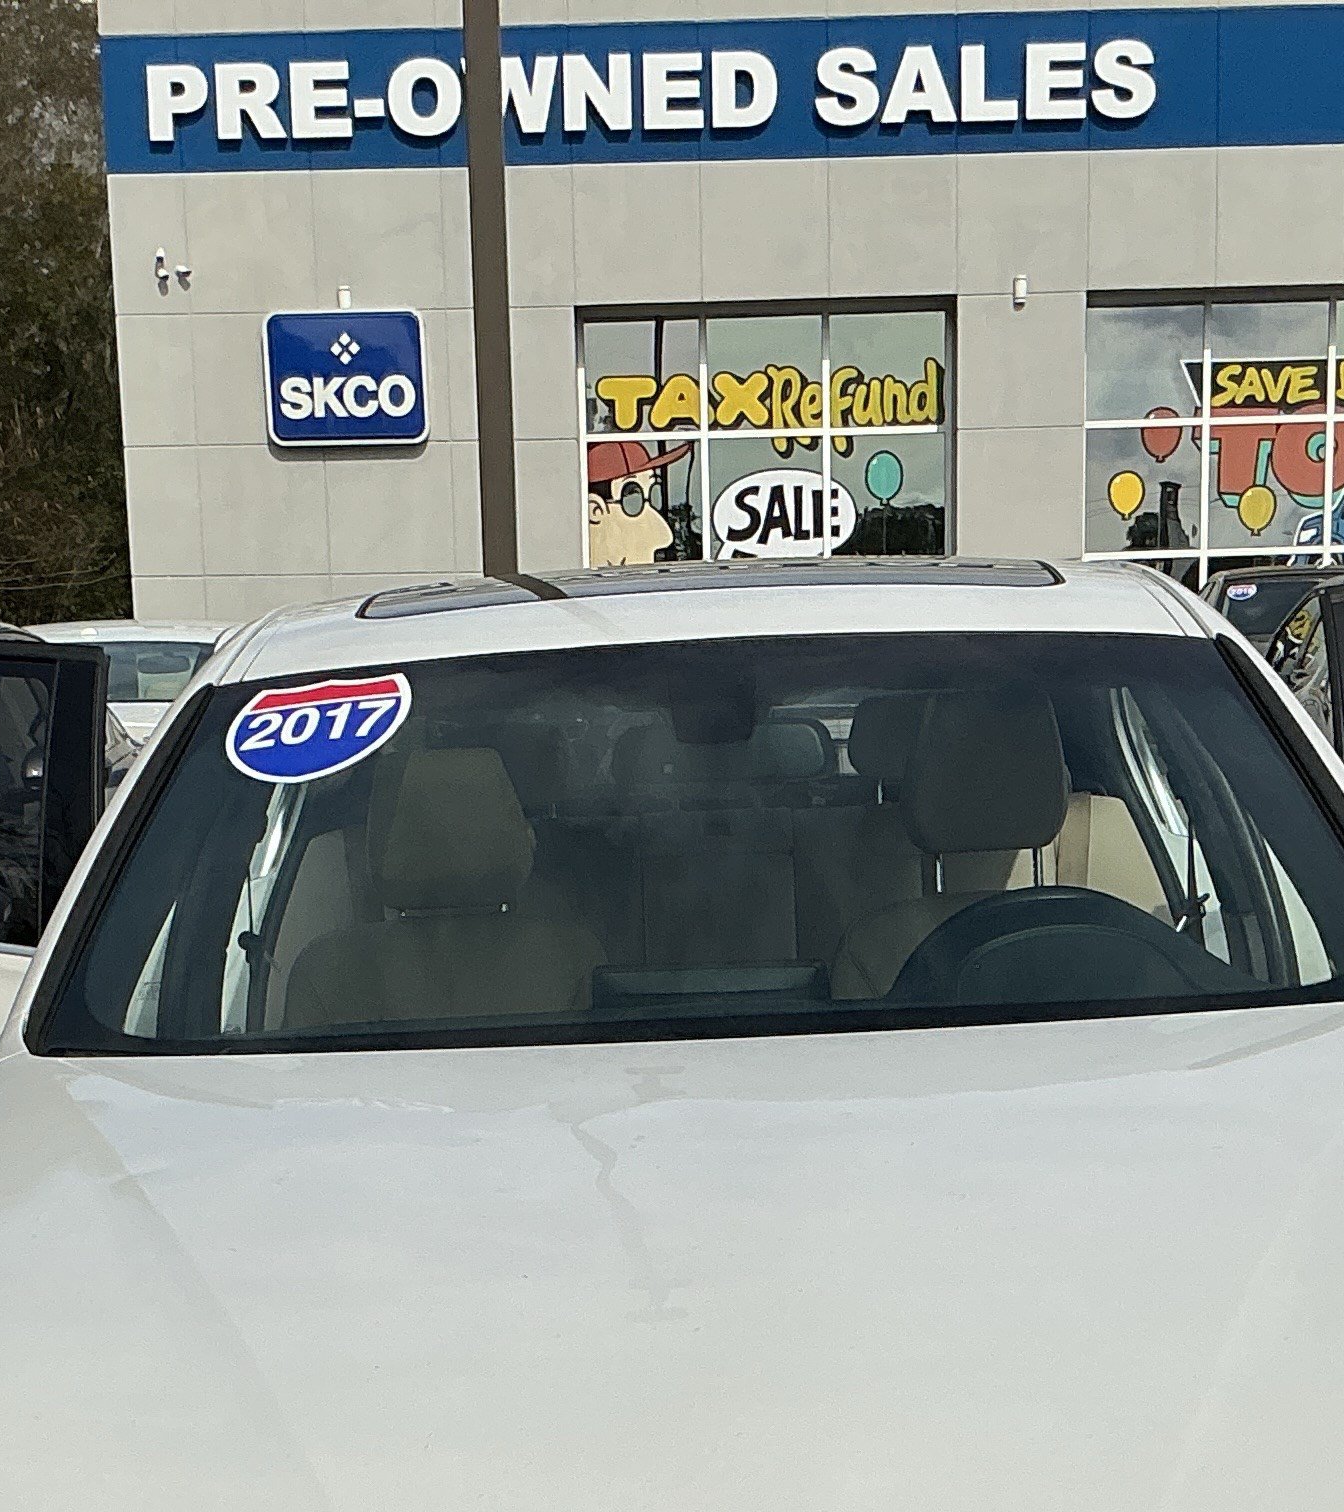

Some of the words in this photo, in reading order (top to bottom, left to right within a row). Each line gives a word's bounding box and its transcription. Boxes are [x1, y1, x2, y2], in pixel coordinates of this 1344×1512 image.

[145, 51, 779, 142] PRE-OWNED
[814, 39, 1157, 127] SALES
[279, 374, 417, 420] SKCO
[596, 372, 770, 430] TAX
[766, 358, 945, 458] Refund
[1212, 364, 1320, 408] SAVE
[726, 484, 840, 544] SALE
[238, 699, 397, 751] 2017
